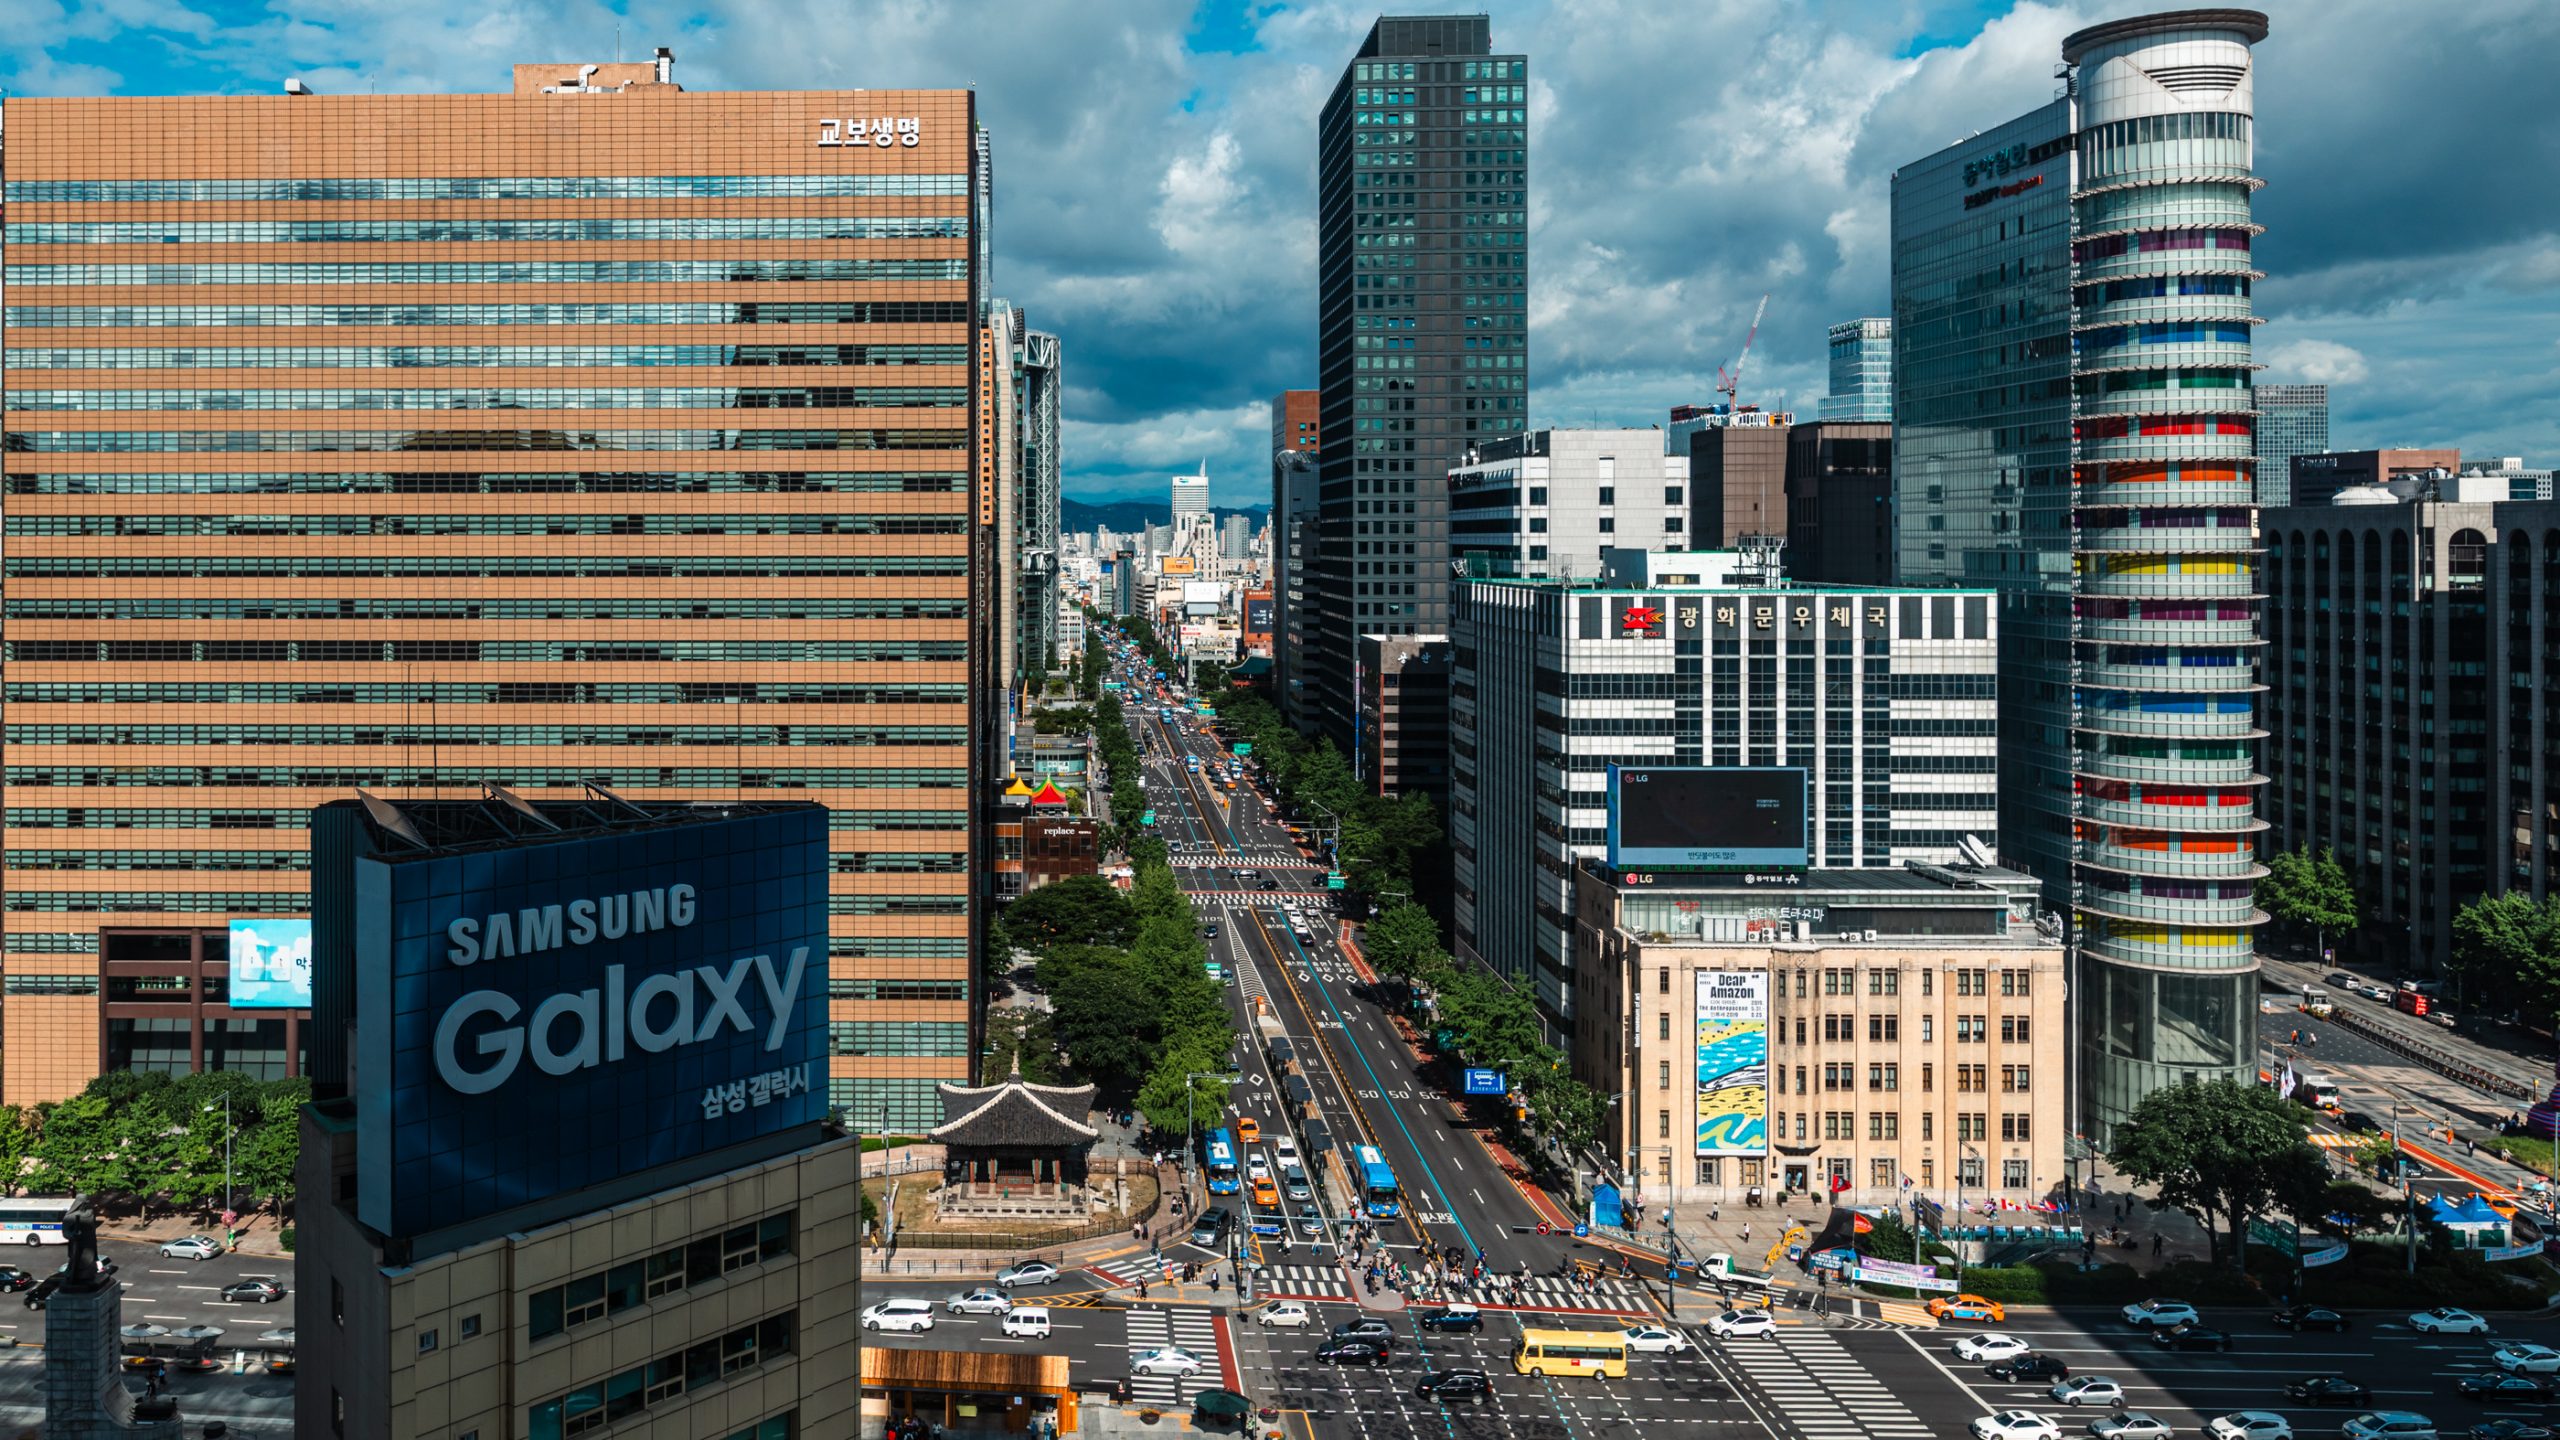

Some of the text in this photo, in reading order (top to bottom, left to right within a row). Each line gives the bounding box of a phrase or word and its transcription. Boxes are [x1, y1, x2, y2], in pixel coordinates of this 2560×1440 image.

[817, 116, 920, 148] 교보생명
[1679, 606, 1887, 628] 광화문우체국
[1636, 774, 1648, 782] LG
[1044, 826, 1076, 837] replace
[1639, 874, 1653, 884] LG
[1779, 907, 1824, 922] 트라우마
[447, 883, 696, 966] SAMSUNG
[1718, 974, 1746, 986] Dear
[1710, 986, 1755, 999] Amazon
[433, 946, 810, 1095] Galaxy
[701, 1062, 811, 1120] 삼성 갤럭시
[1358, 1089, 1380, 1099] 50
[1388, 1090, 1410, 1099] 50
